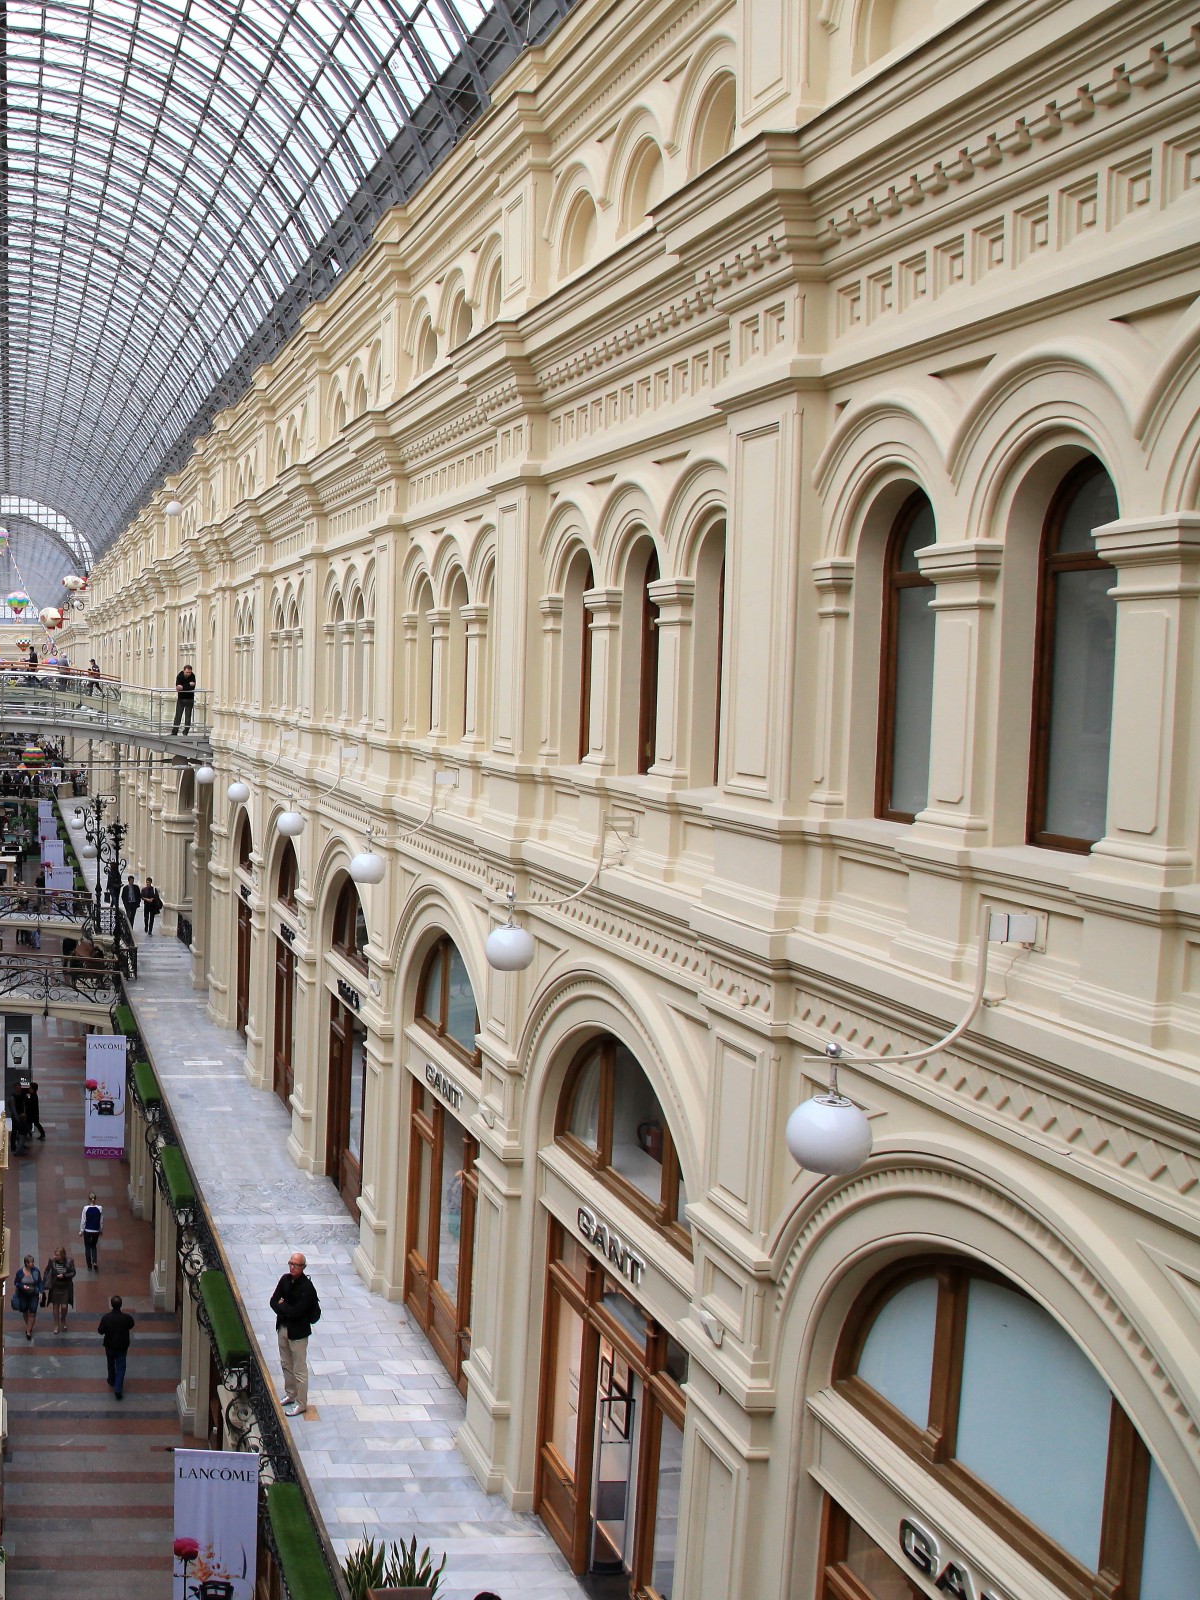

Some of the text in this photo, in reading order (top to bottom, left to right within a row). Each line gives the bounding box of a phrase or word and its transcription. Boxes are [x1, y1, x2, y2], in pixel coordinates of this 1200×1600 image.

[88, 1042, 125, 1051] LANCÔME
[425, 1062, 464, 1113] GANT
[85, 1148, 123, 1156] ARTICOLI
[577, 1205, 647, 1287] GANT
[178, 1466, 256, 1482] LANCÔME
[898, 1516, 1002, 1600] GA
